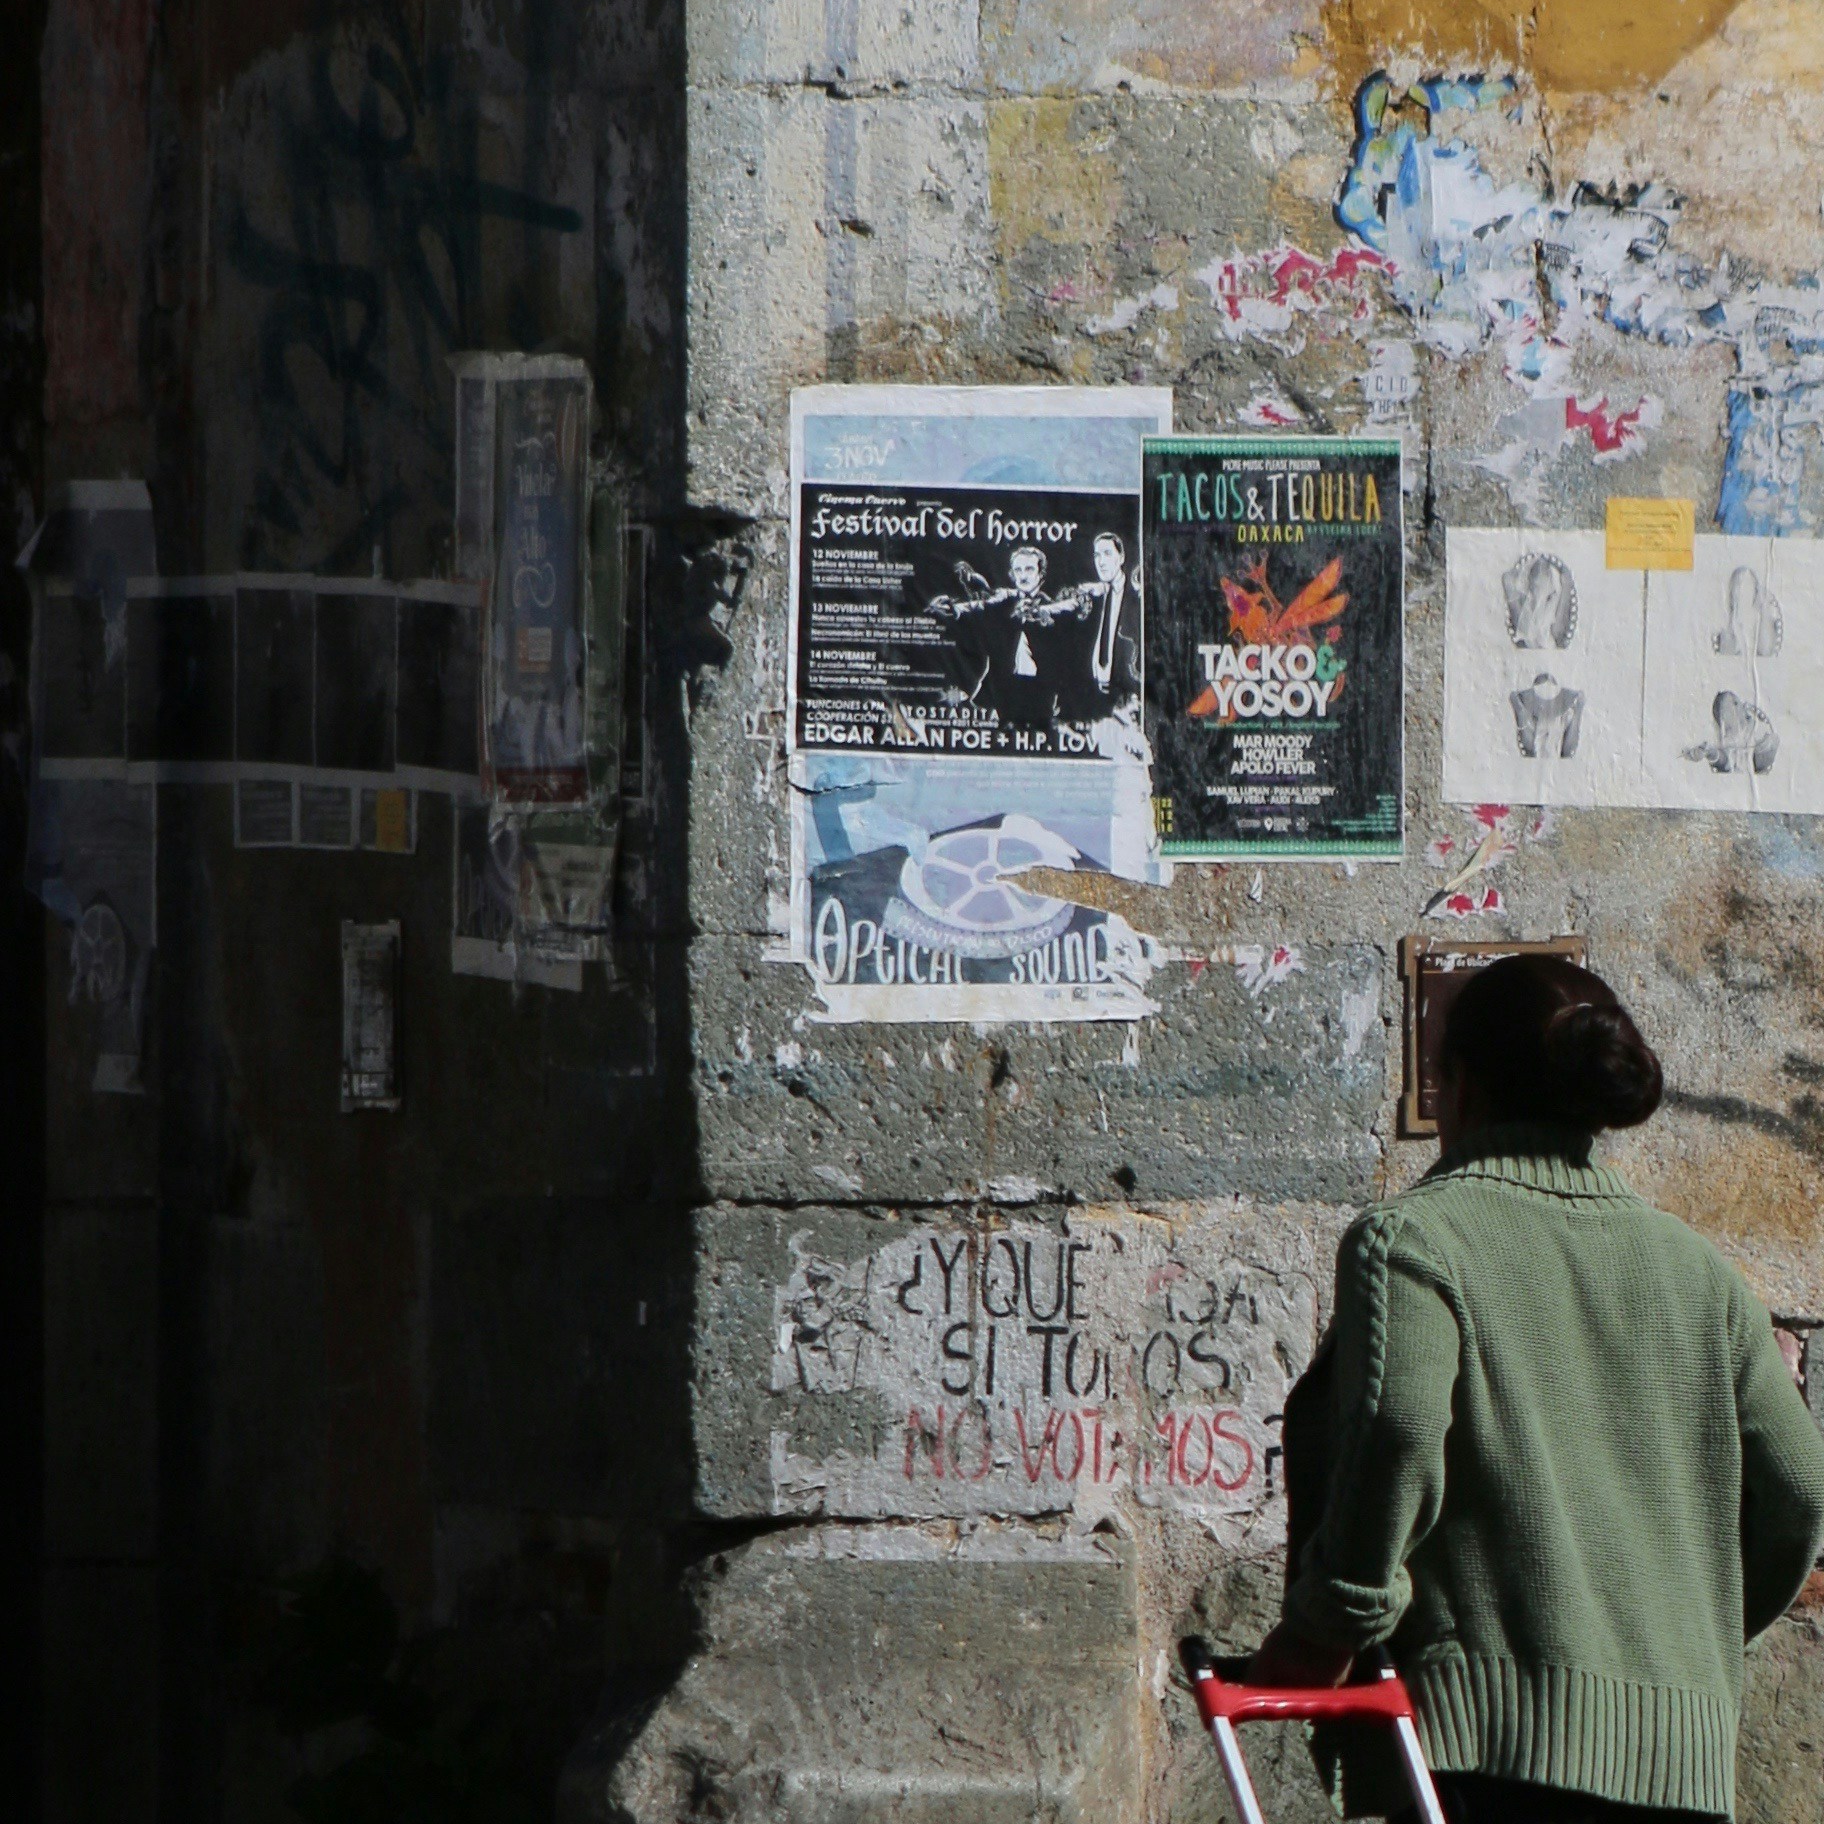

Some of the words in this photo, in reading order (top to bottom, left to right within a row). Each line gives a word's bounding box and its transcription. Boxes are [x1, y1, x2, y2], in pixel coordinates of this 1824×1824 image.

[936, 508, 984, 540] del
[986, 513, 1079, 546] horror
[1236, 524, 1305, 543] OAXACA
[812, 549, 824, 559] 12
[825, 549, 880, 562] NOVIEMBRE
[825, 603, 879, 616] NOVIEMBRE
[811, 650, 822, 660] 14
[823, 650, 877, 662] NOVIEMBRE
[805, 698, 861, 711] FUNCIONES
[1211, 682, 1337, 717] YOSOY
[806, 711, 879, 724] COOPERACIÓN
[906, 705, 1000, 721] TOSTADITA
[803, 723, 875, 746] EDGAR
[879, 726, 945, 749] ALLAN
[950, 729, 992, 750] POE
[1015, 730, 1052, 752] H.P.
[1233, 734, 1263, 748] MAR
[1264, 734, 1314, 749] MOODY
[1230, 761, 1275, 775] APOLO
[1276, 761, 1318, 775] FEVER
[941, 1322, 997, 1397] SI
[904, 1404, 994, 1482] NO
